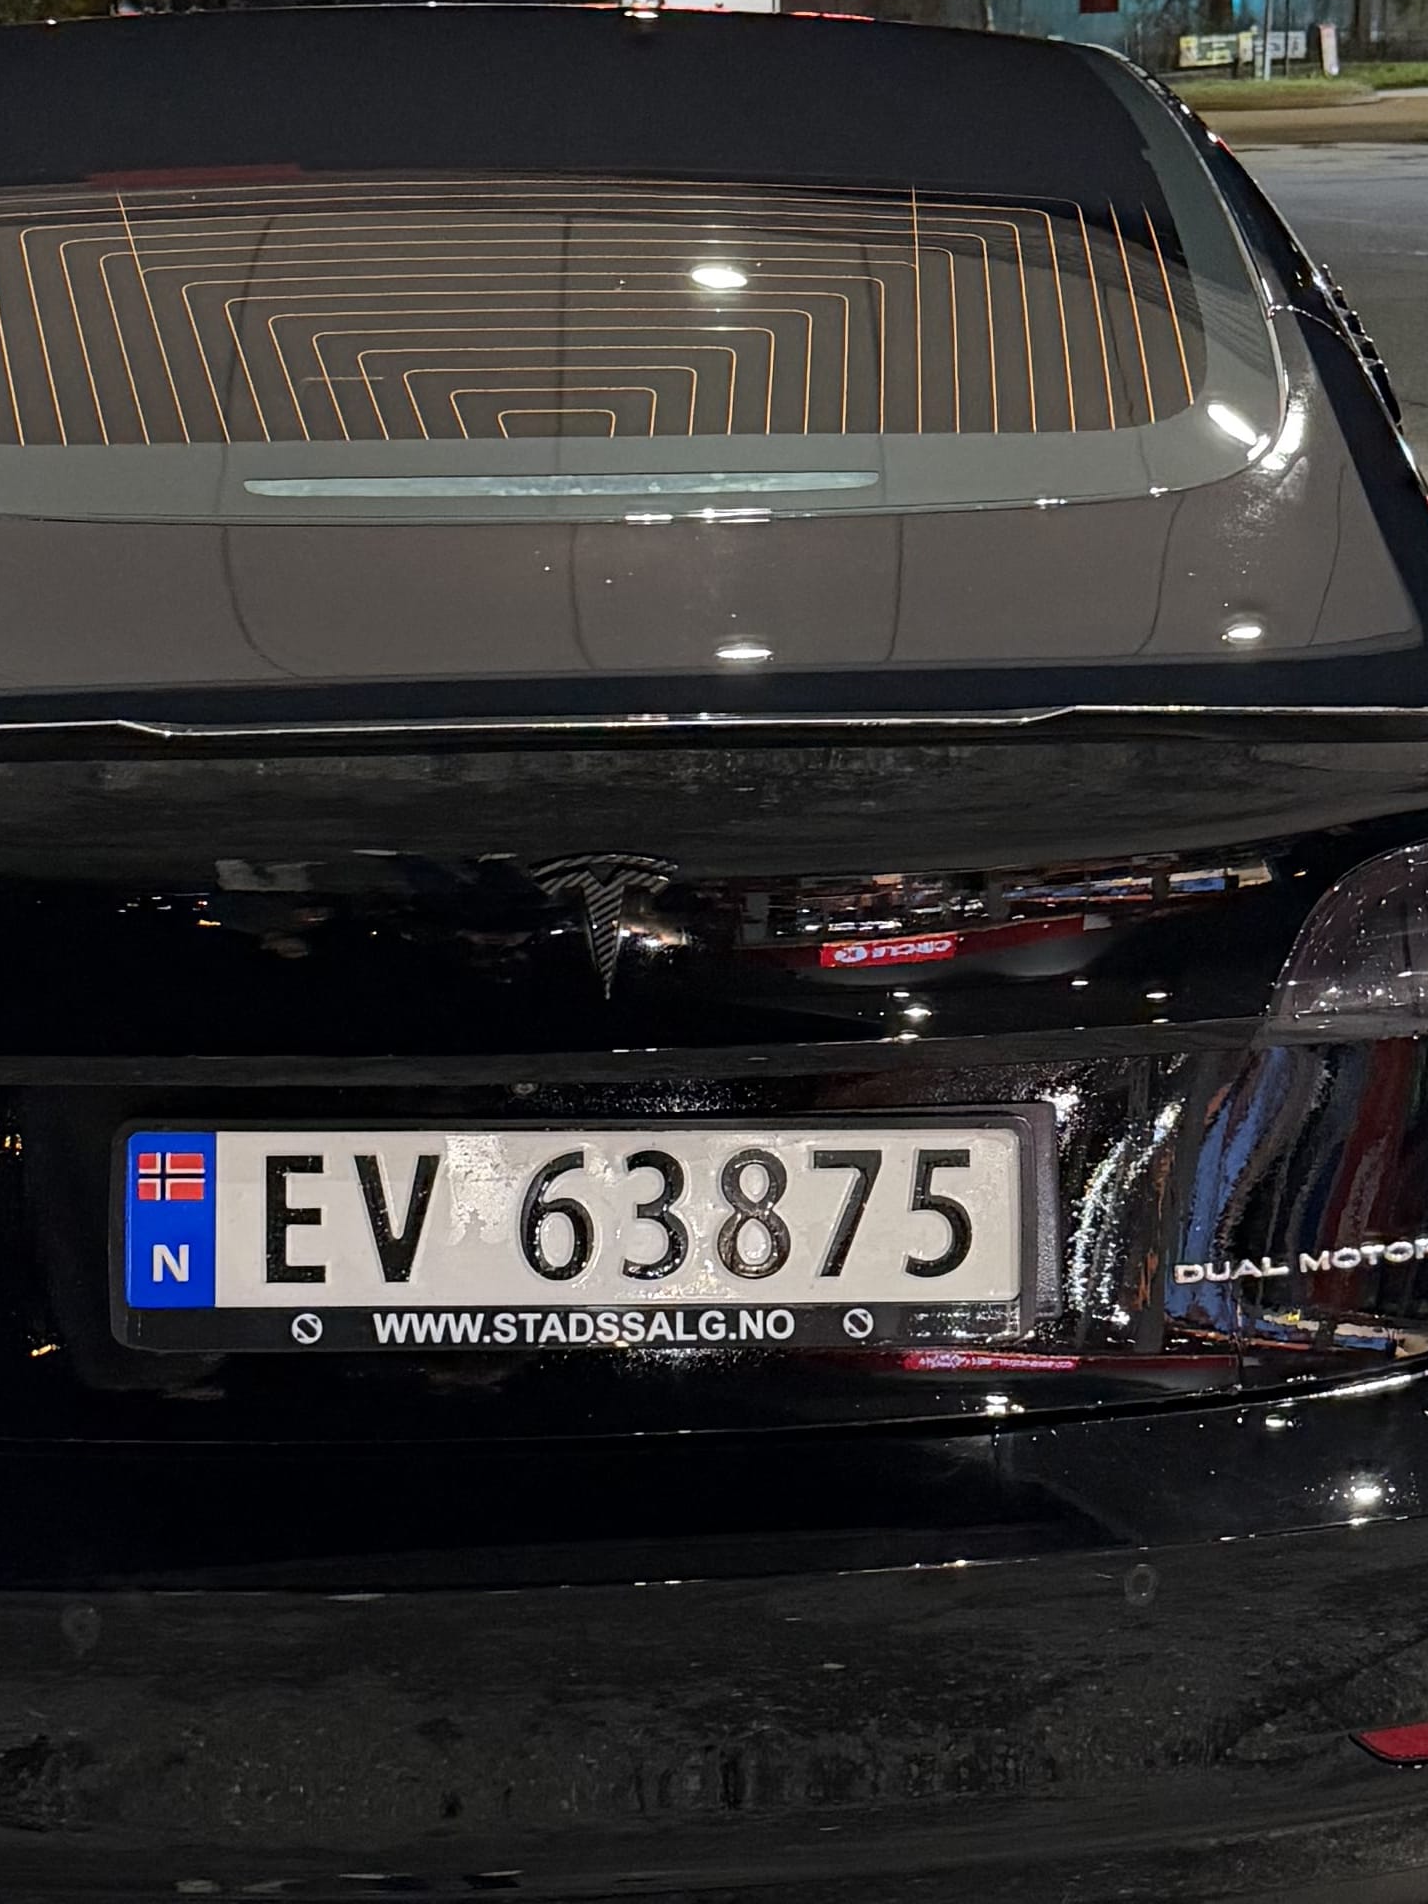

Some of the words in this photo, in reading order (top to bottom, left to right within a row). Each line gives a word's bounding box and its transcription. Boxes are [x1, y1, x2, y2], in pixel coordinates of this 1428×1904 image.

[265, 1153, 440, 1284] EV
[520, 1148, 974, 1282] 63875
[152, 1243, 190, 1283] N
[1173, 1256, 1290, 1284] DUAL
[373, 1310, 796, 1344] WWW.STADSSALG.NO
